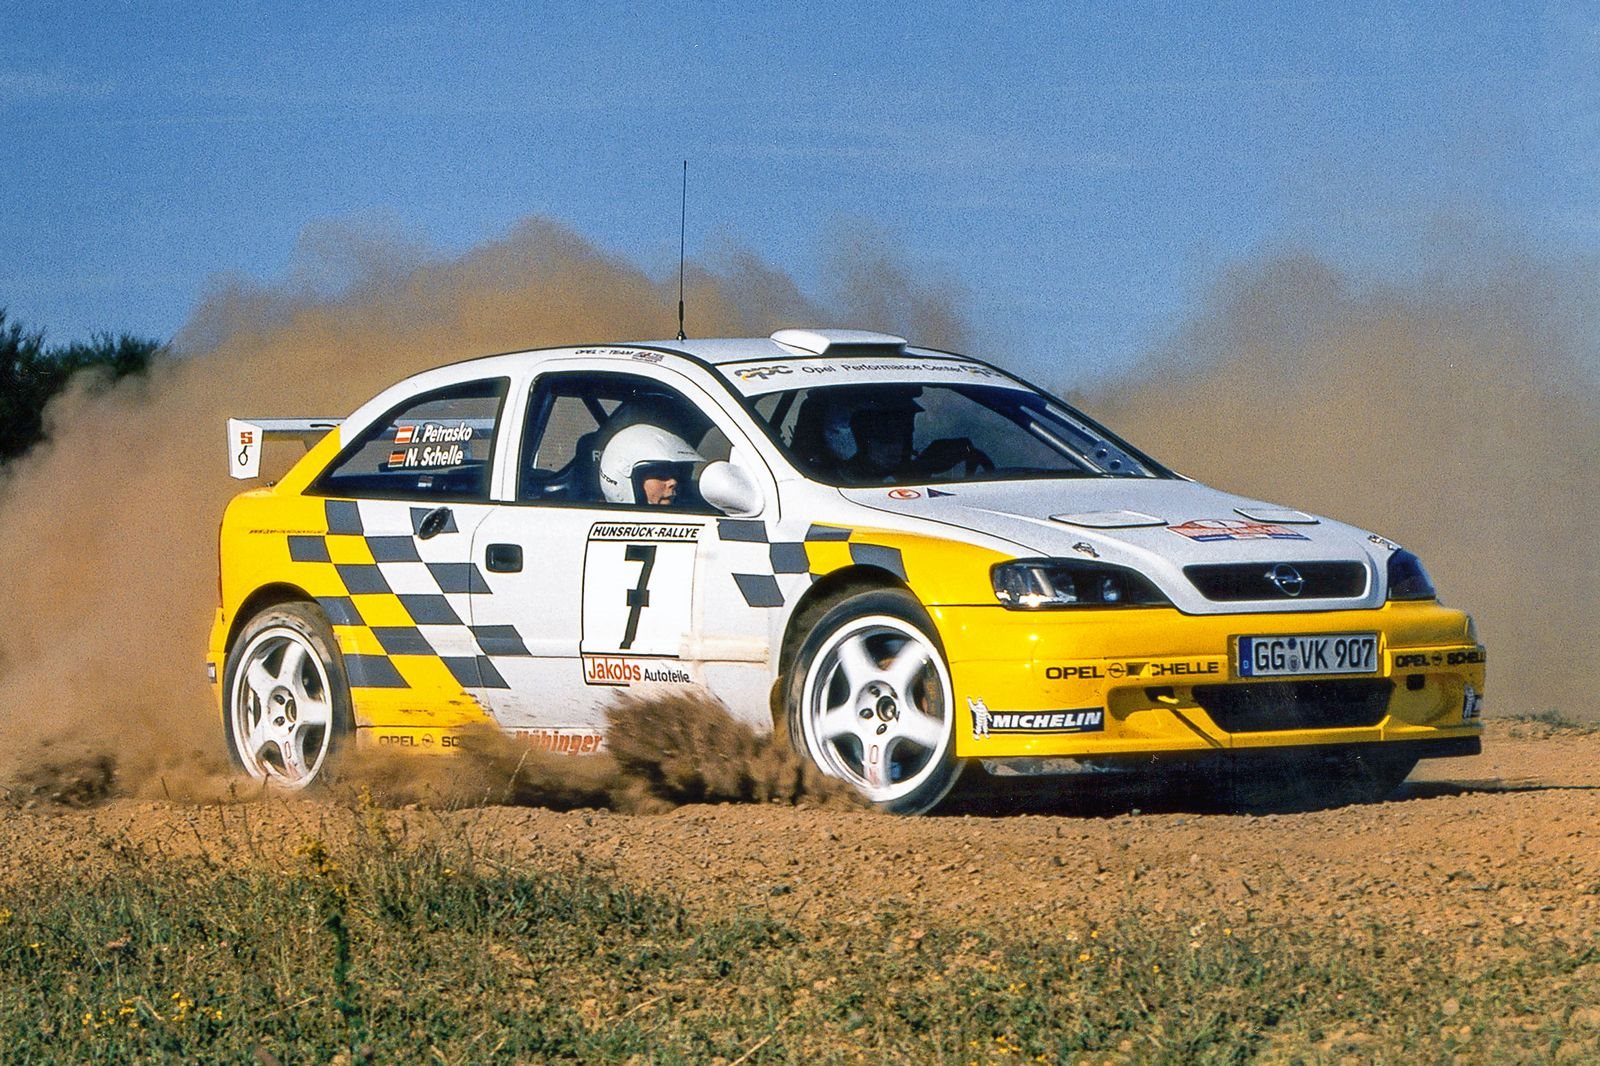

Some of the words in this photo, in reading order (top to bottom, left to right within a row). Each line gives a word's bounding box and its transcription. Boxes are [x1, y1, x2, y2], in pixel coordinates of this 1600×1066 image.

[801, 365, 837, 374] Opel
[841, 363, 922, 371] Performance
[411, 425, 421, 444] I.
[421, 421, 473, 444] Petrasko
[404, 447, 419, 467] N.
[420, 444, 464, 466] Schelle
[619, 544, 658, 650] 7
[1254, 641, 1286, 671] GG
[1300, 638, 1329, 669] VK
[1334, 637, 1376, 668] 907
[1395, 654, 1430, 668] OPEL
[1447, 651, 1485, 665] SCHELL
[588, 657, 641, 681] Jakobs
[644, 668, 691, 683] Autoteile
[1045, 666, 1104, 680] OPEL
[1151, 661, 1219, 676] CHELLE
[992, 711, 1102, 728] MICHELIN
[378, 735, 419, 747] OPEL
